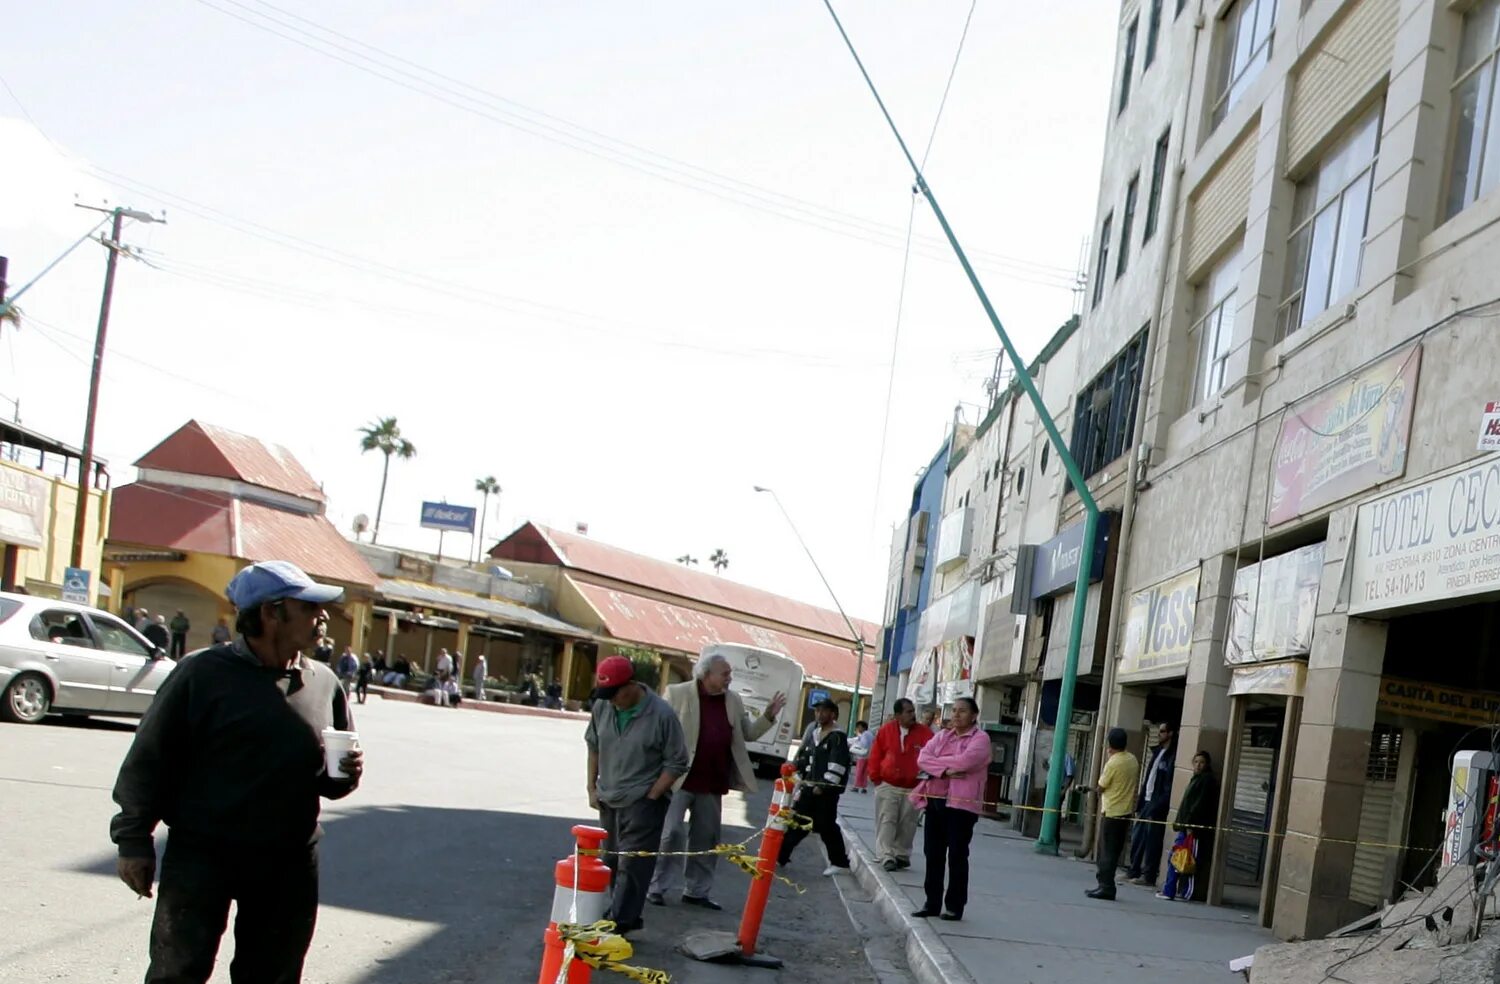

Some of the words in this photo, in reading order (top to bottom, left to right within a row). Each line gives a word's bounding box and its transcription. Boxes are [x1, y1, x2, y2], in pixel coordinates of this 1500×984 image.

[1368, 487, 1434, 557] HOTEL
[1386, 555, 1420, 571] REFORMA
[1443, 543, 1467, 559] ZONA
[1469, 558, 1480, 570] por
[1365, 580, 1382, 601] TEL.
[1385, 571, 1426, 597] 54-10-13
